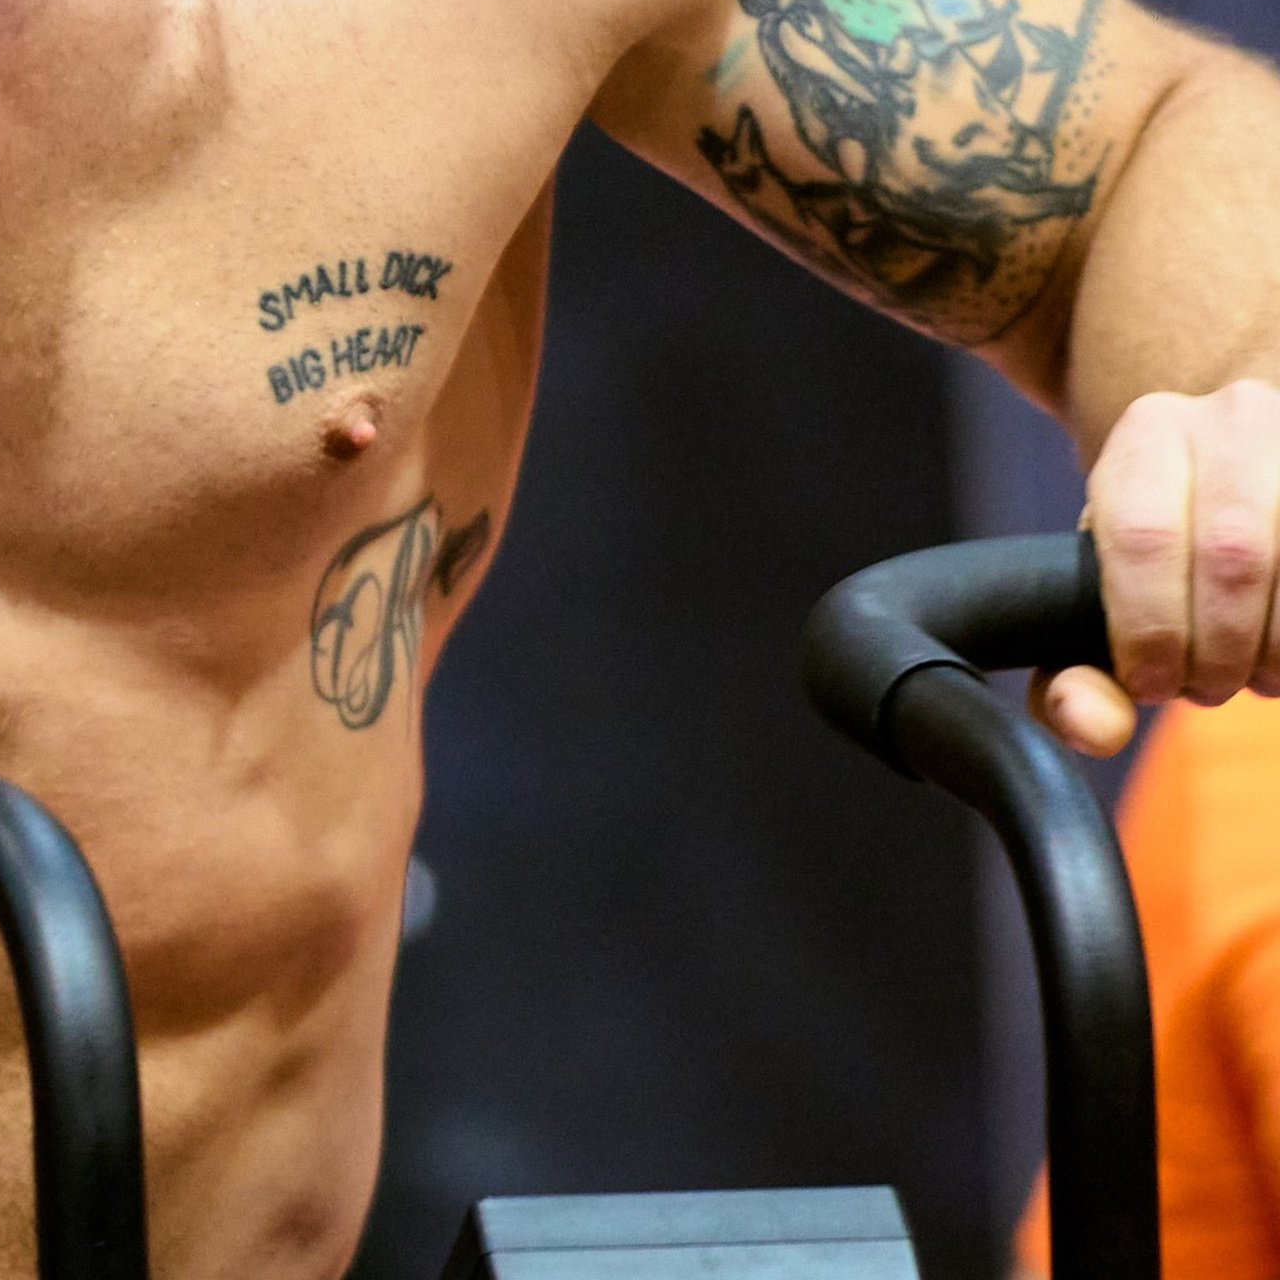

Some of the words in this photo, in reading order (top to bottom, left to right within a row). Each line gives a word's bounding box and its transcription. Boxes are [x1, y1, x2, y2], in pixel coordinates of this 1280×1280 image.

[258, 258, 369, 332] SMALL
[379, 250, 454, 300] DICK
[266, 348, 326, 405] BIG
[330, 322, 425, 377] HEART
